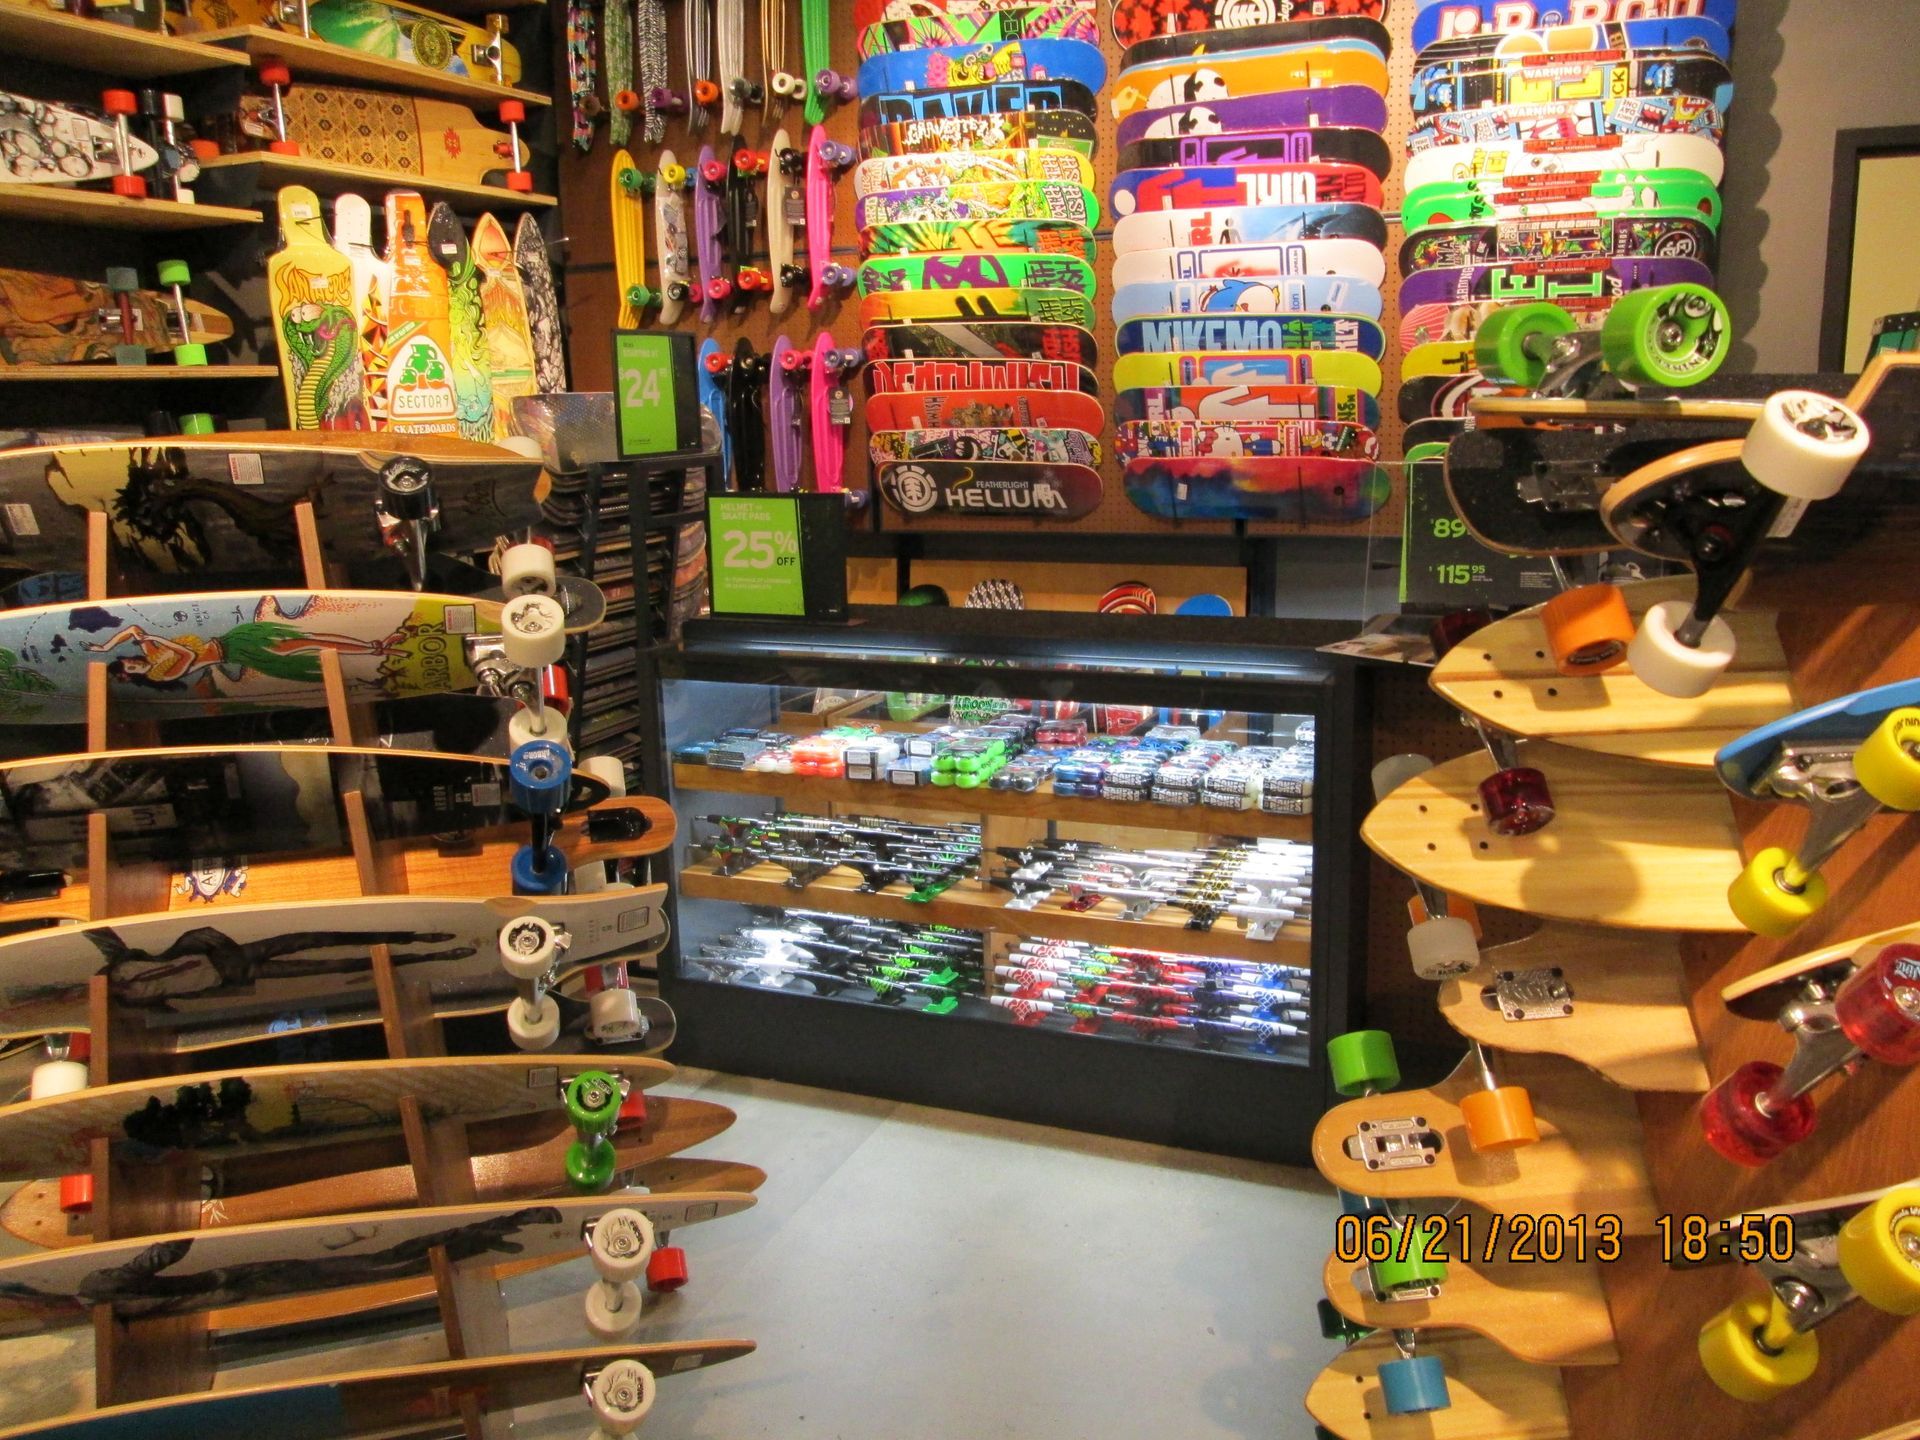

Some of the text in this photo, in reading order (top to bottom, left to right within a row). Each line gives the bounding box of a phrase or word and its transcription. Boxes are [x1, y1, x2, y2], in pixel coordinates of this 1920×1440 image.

[399, 394, 442, 409] SECTOR
[394, 423, 457, 435] SKATEBOARDS
[976, 480, 1029, 489] FEATHERLIGHT
[776, 556, 796, 567] OFF
[417, 622, 452, 690] ARBOR
